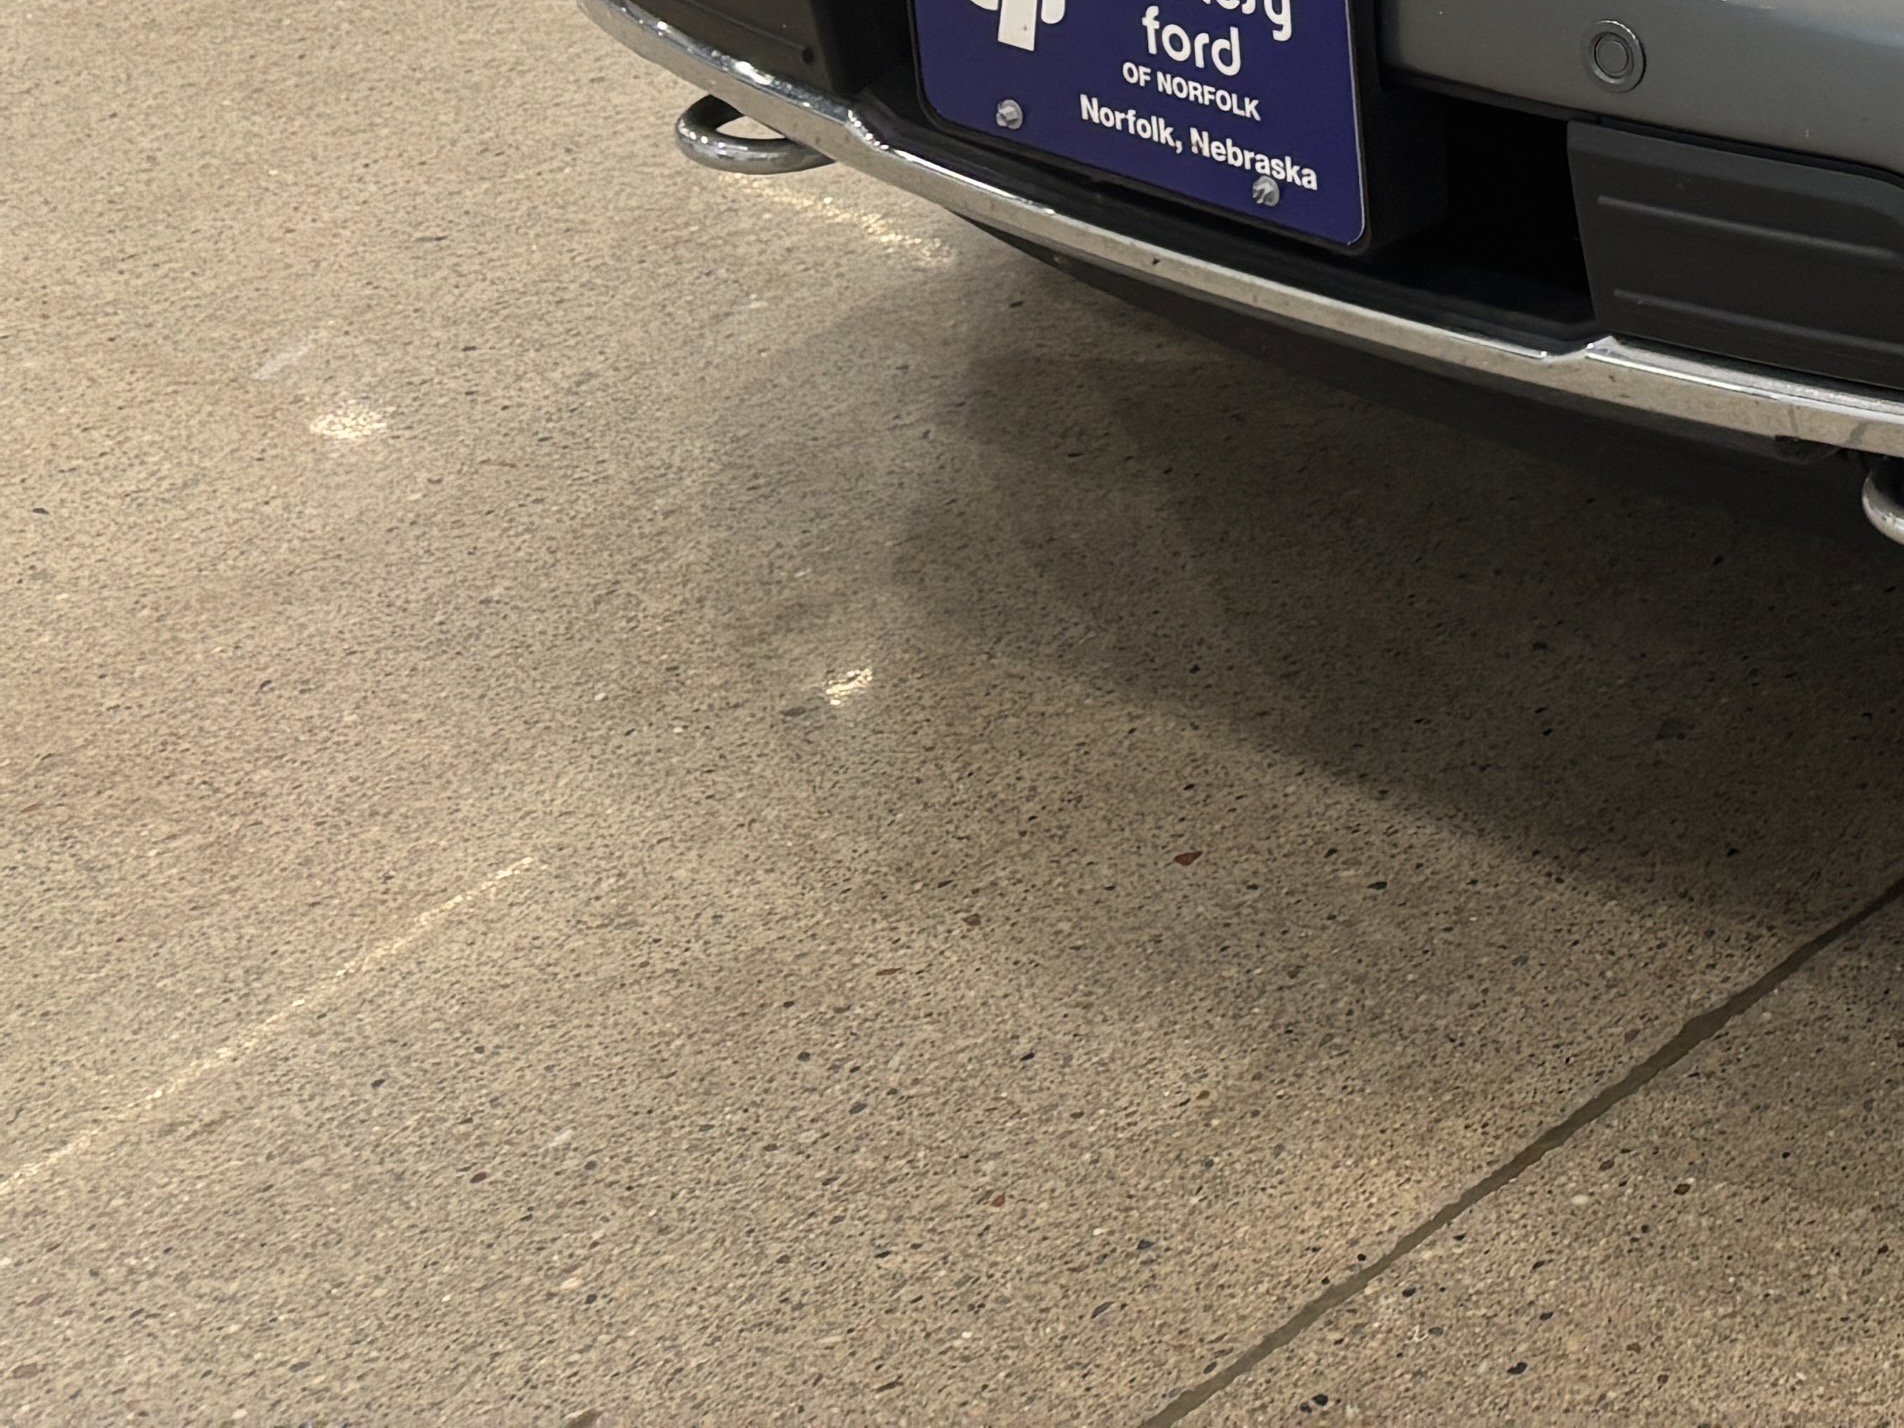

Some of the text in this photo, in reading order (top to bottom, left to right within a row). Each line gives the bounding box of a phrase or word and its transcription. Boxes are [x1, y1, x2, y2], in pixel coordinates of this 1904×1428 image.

[1142, 5, 1242, 76] ford
[1122, 62, 1261, 122] OF NORFOLK
[1080, 94, 1318, 191] Norfolk, Nebraska
